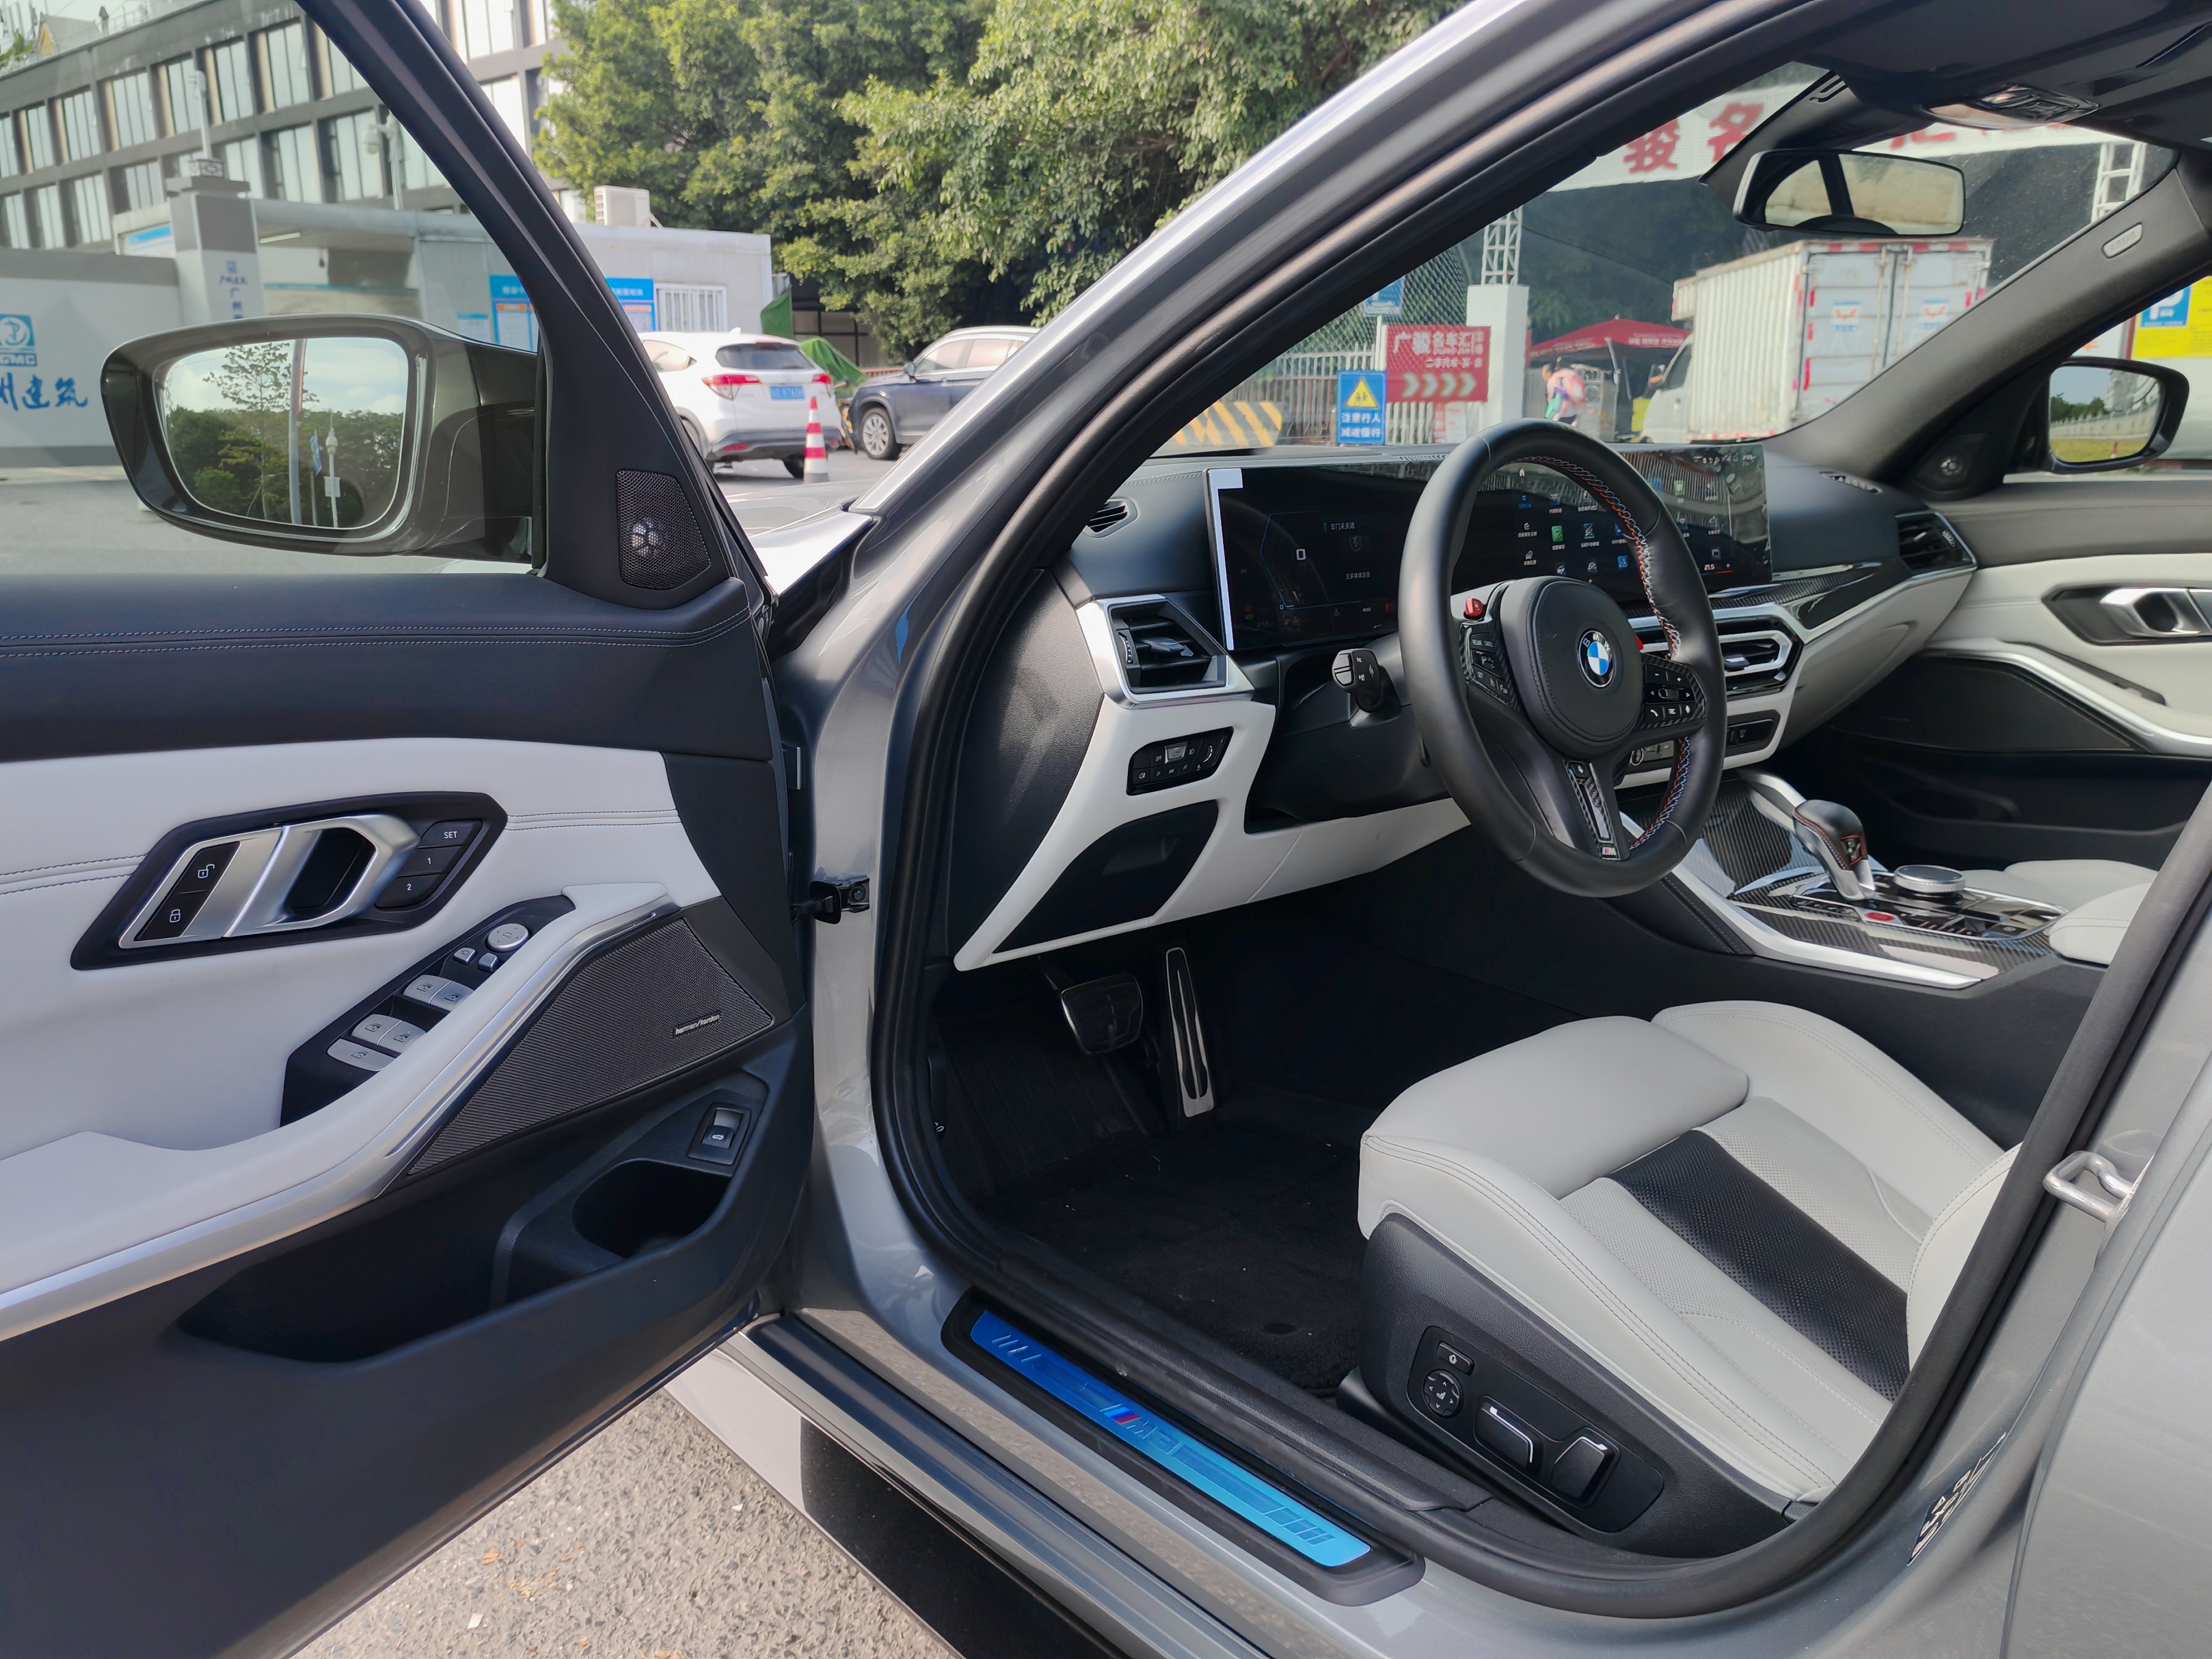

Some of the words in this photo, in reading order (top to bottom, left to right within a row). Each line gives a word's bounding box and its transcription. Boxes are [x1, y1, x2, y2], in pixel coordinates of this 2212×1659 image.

[2109, 231, 2136, 253] AIRBAG
[1341, 412, 1380, 424] 注意行人
[1341, 427, 1380, 438] 减速慢行
[1331, 522, 1355, 530] 车门未关闭
[1296, 549, 1306, 560] 0
[1582, 633, 1611, 651] BMW
